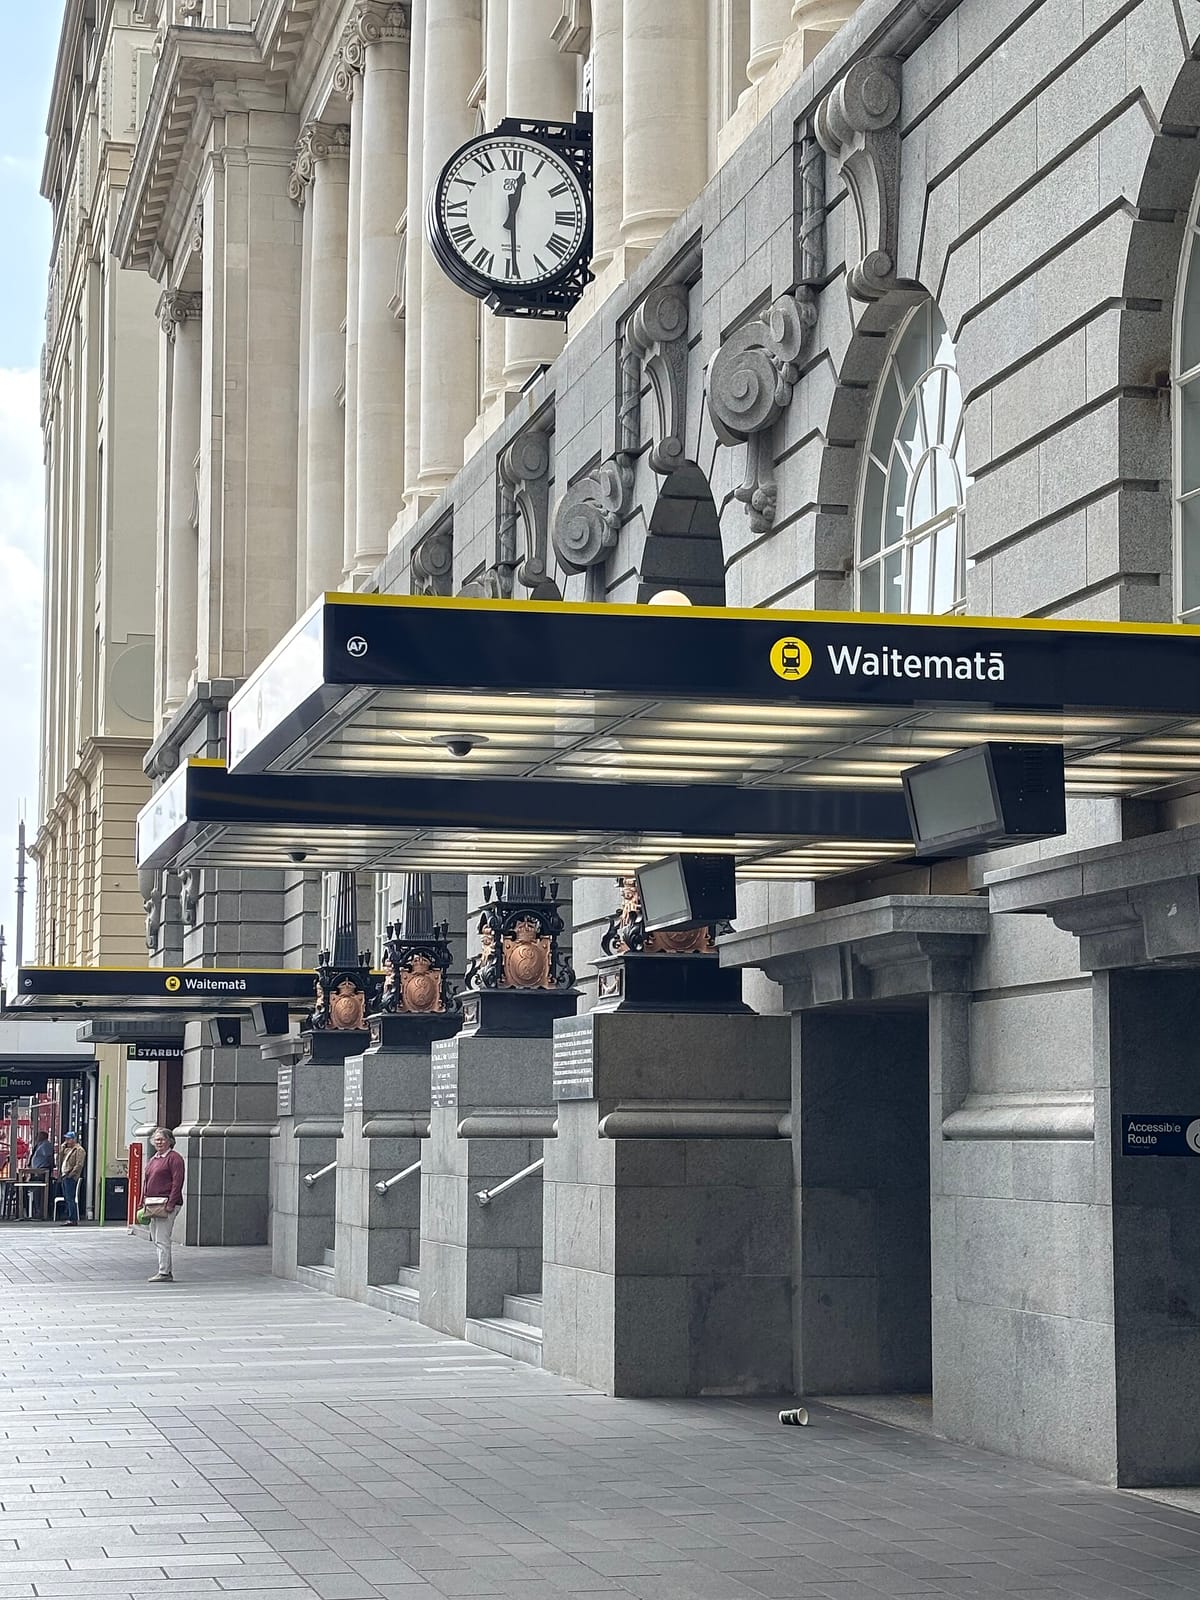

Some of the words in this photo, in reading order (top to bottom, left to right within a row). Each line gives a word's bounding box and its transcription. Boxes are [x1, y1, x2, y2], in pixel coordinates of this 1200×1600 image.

[471, 152, 496, 178] XI
[500, 149, 524, 171] XII
[532, 159, 546, 178] I
[452, 172, 477, 194] X
[547, 181, 570, 198] II
[447, 200, 467, 217] IX
[555, 211, 576, 228] III
[450, 223, 477, 254] VIII
[545, 232, 571, 260] IIII
[471, 247, 495, 274] VII
[533, 253, 549, 275] V
[827, 645, 1005, 681] Waitematā
[185, 978, 246, 990] Waitematā
[1127, 1121, 1182, 1133] Accessible
[1127, 1133, 1158, 1144] Route
